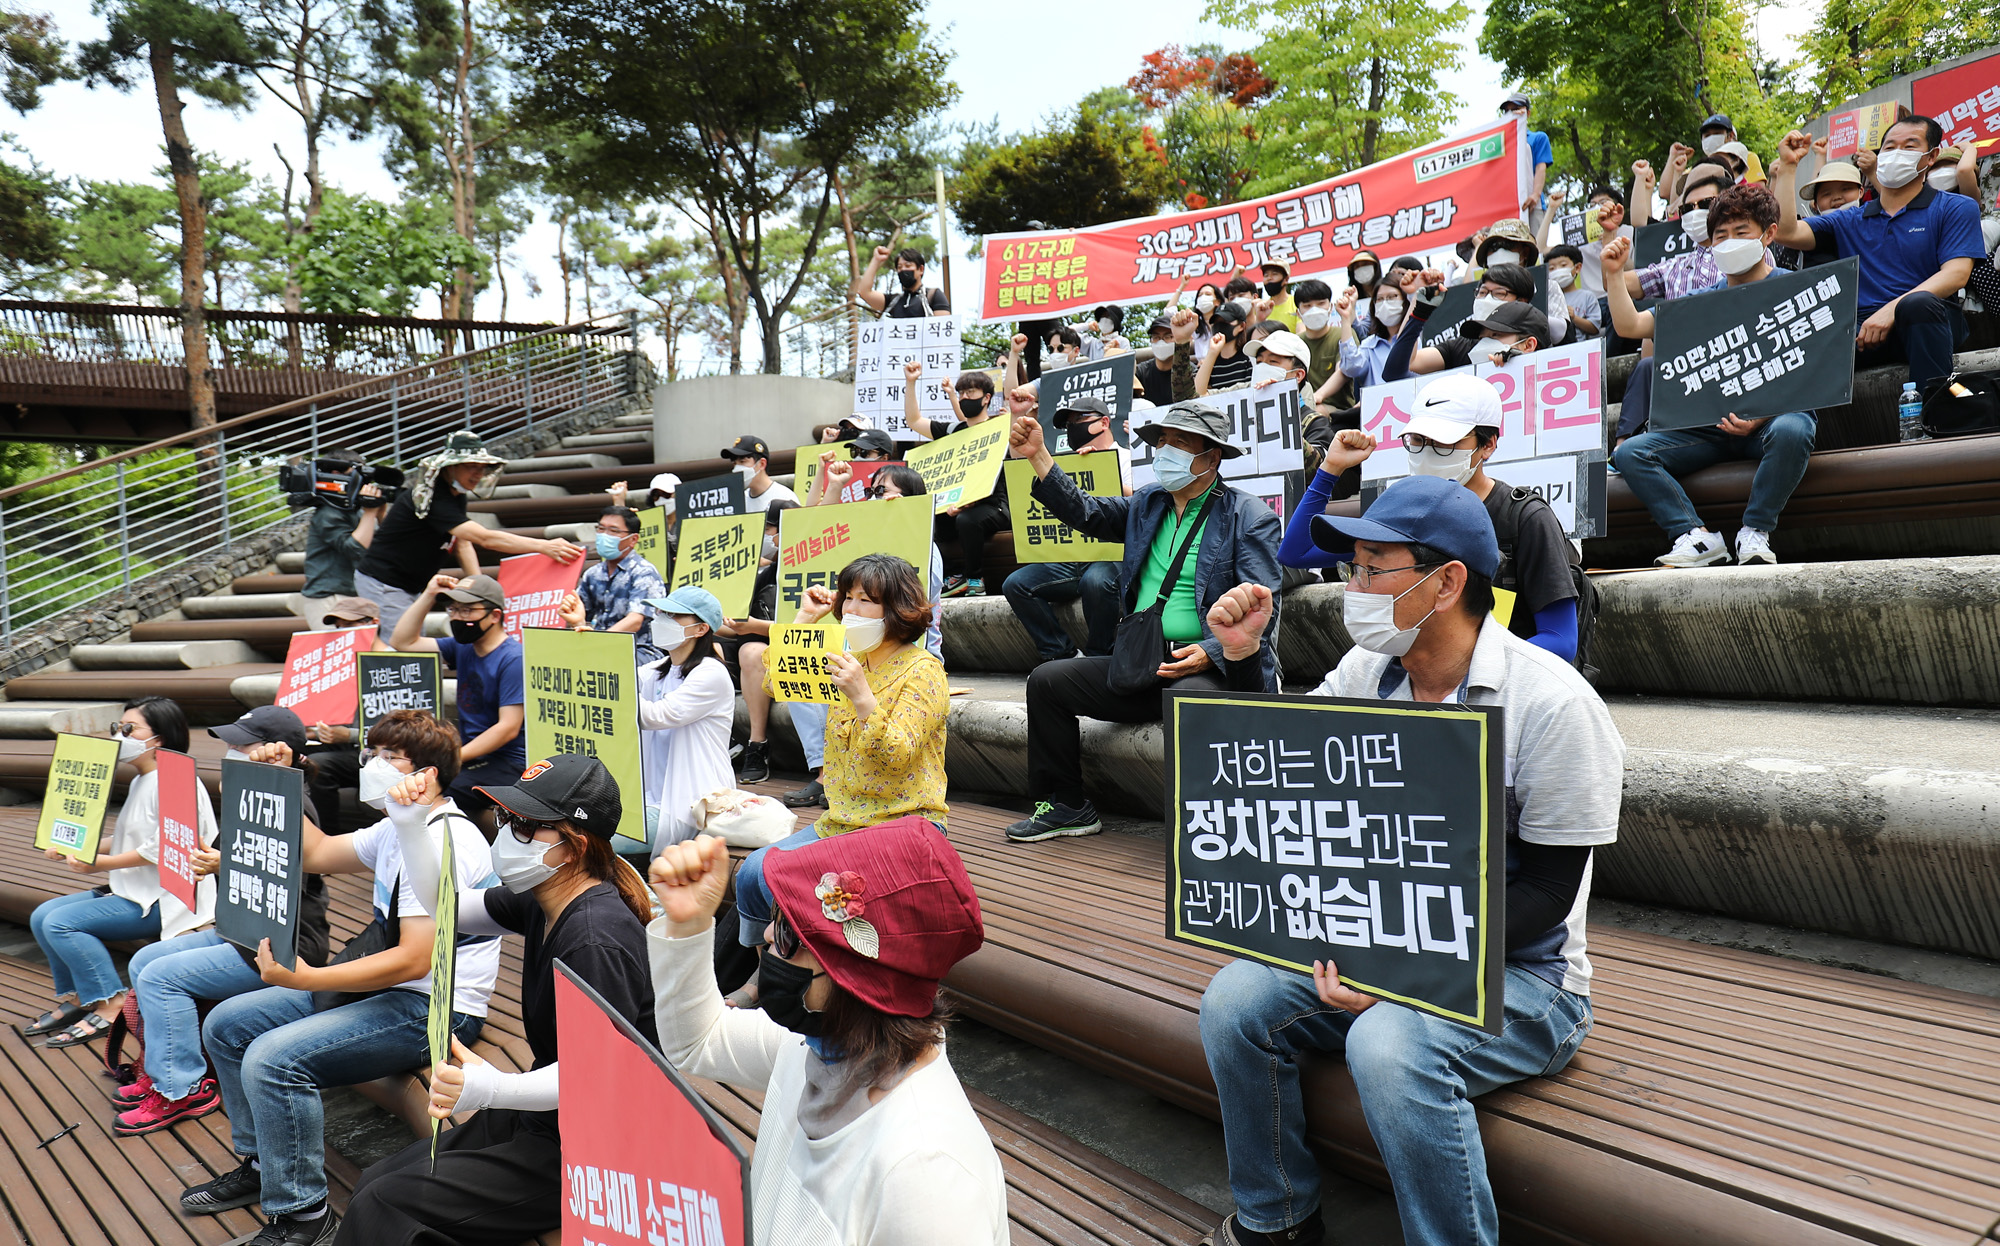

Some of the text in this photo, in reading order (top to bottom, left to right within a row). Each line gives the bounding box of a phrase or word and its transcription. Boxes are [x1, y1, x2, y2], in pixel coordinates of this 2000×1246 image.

[1421, 147, 1474, 174] 617위헌
[1137, 182, 1364, 256] 30만세대 소급피해
[1002, 238, 1076, 261] 617규제
[1132, 197, 1457, 283] 계약당시 기준을 적용해라
[999, 255, 1087, 284] 소급적용은
[998, 277, 1088, 308] 명백한 위헌
[888, 324, 918, 340] 소급
[928, 321, 956, 337] 적용
[1660, 274, 1841, 381] 30만세대 소급피해
[1680, 305, 1835, 396] 계약당시 기준을
[1063, 367, 1112, 392] 617규제
[1719, 346, 1806, 397] 적용해라
[911, 431, 1001, 471] 30만세대 소급피해
[920, 448, 989, 480] 약당시 기준을
[688, 487, 729, 509] 617규제
[690, 523, 744, 563] 국토부가
[1026, 523, 1073, 545] 명백한
[709, 544, 755, 580] 죽인다!
[292, 631, 355, 672] 우리의 권리를
[783, 629, 824, 648] 617규제
[290, 648, 354, 689] 무능한 정부가
[369, 663, 422, 688] 저희는 어떤
[530, 665, 620, 701] 30만세대 소급피해
[778, 655, 832, 676] 소급적용은
[779, 681, 841, 702] 명백한 위헌
[538, 698, 614, 736] 계약당시 기준을
[554, 733, 598, 756] 적용해라
[1208, 732, 1405, 789] 저희는 어떤
[239, 788, 286, 832] 617규제
[164, 816, 180, 845] 부동산
[1184, 798, 1451, 869] 정치집단과도
[164, 844, 180, 874] 산으로
[230, 828, 289, 879] 소급적용은
[228, 869, 288, 926] 명백한 위헌
[1183, 872, 1475, 961] 관계가 없습니다
[566, 1163, 726, 1246] 30만세대 소급피해
